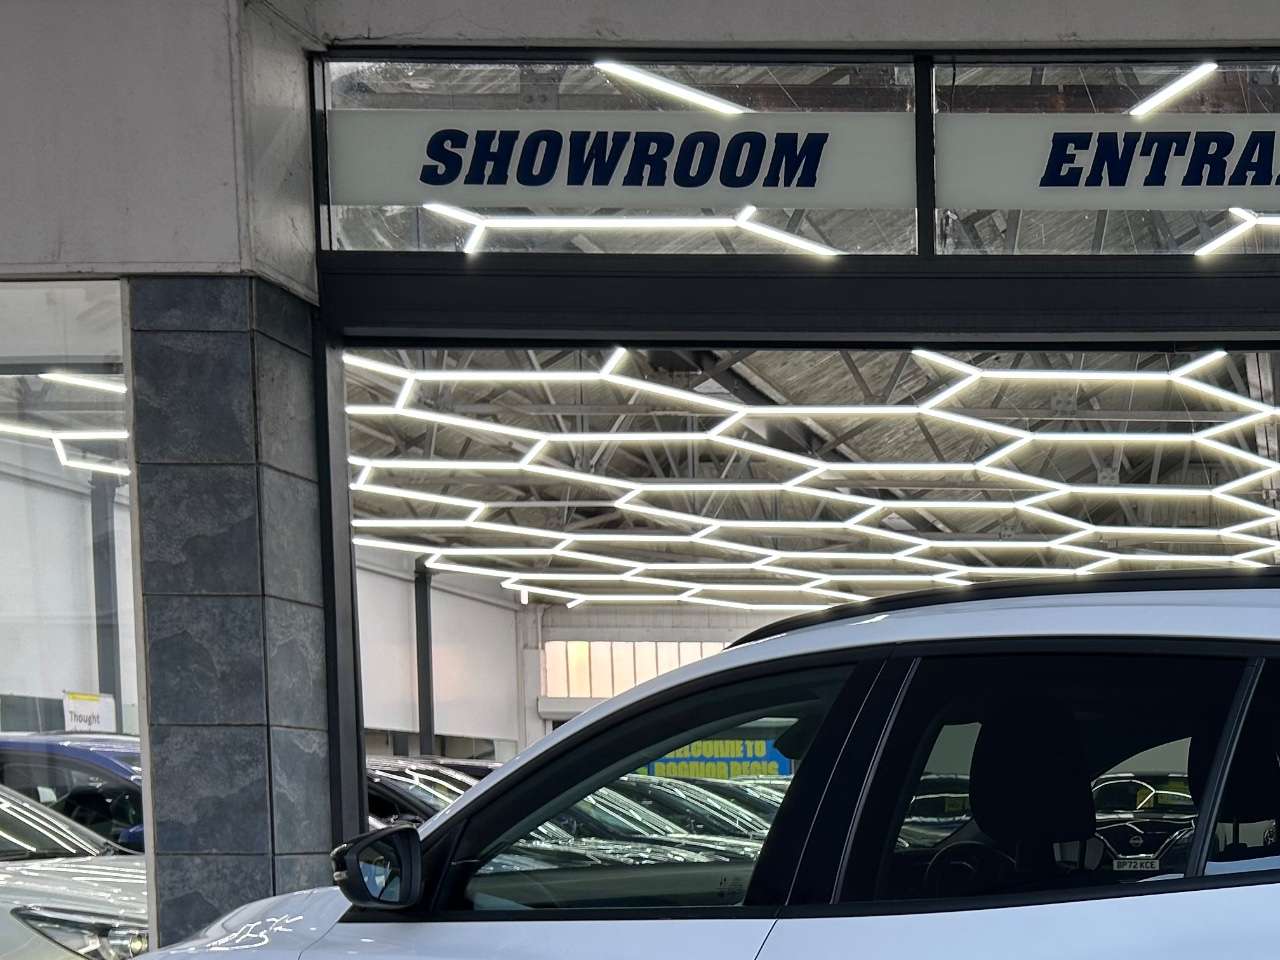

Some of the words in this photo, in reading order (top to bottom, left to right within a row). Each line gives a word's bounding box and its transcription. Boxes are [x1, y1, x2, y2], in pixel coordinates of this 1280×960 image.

[418, 128, 830, 189] SHOWROOM
[69, 711, 101, 726] Thought
[746, 740, 767, 758] TO
